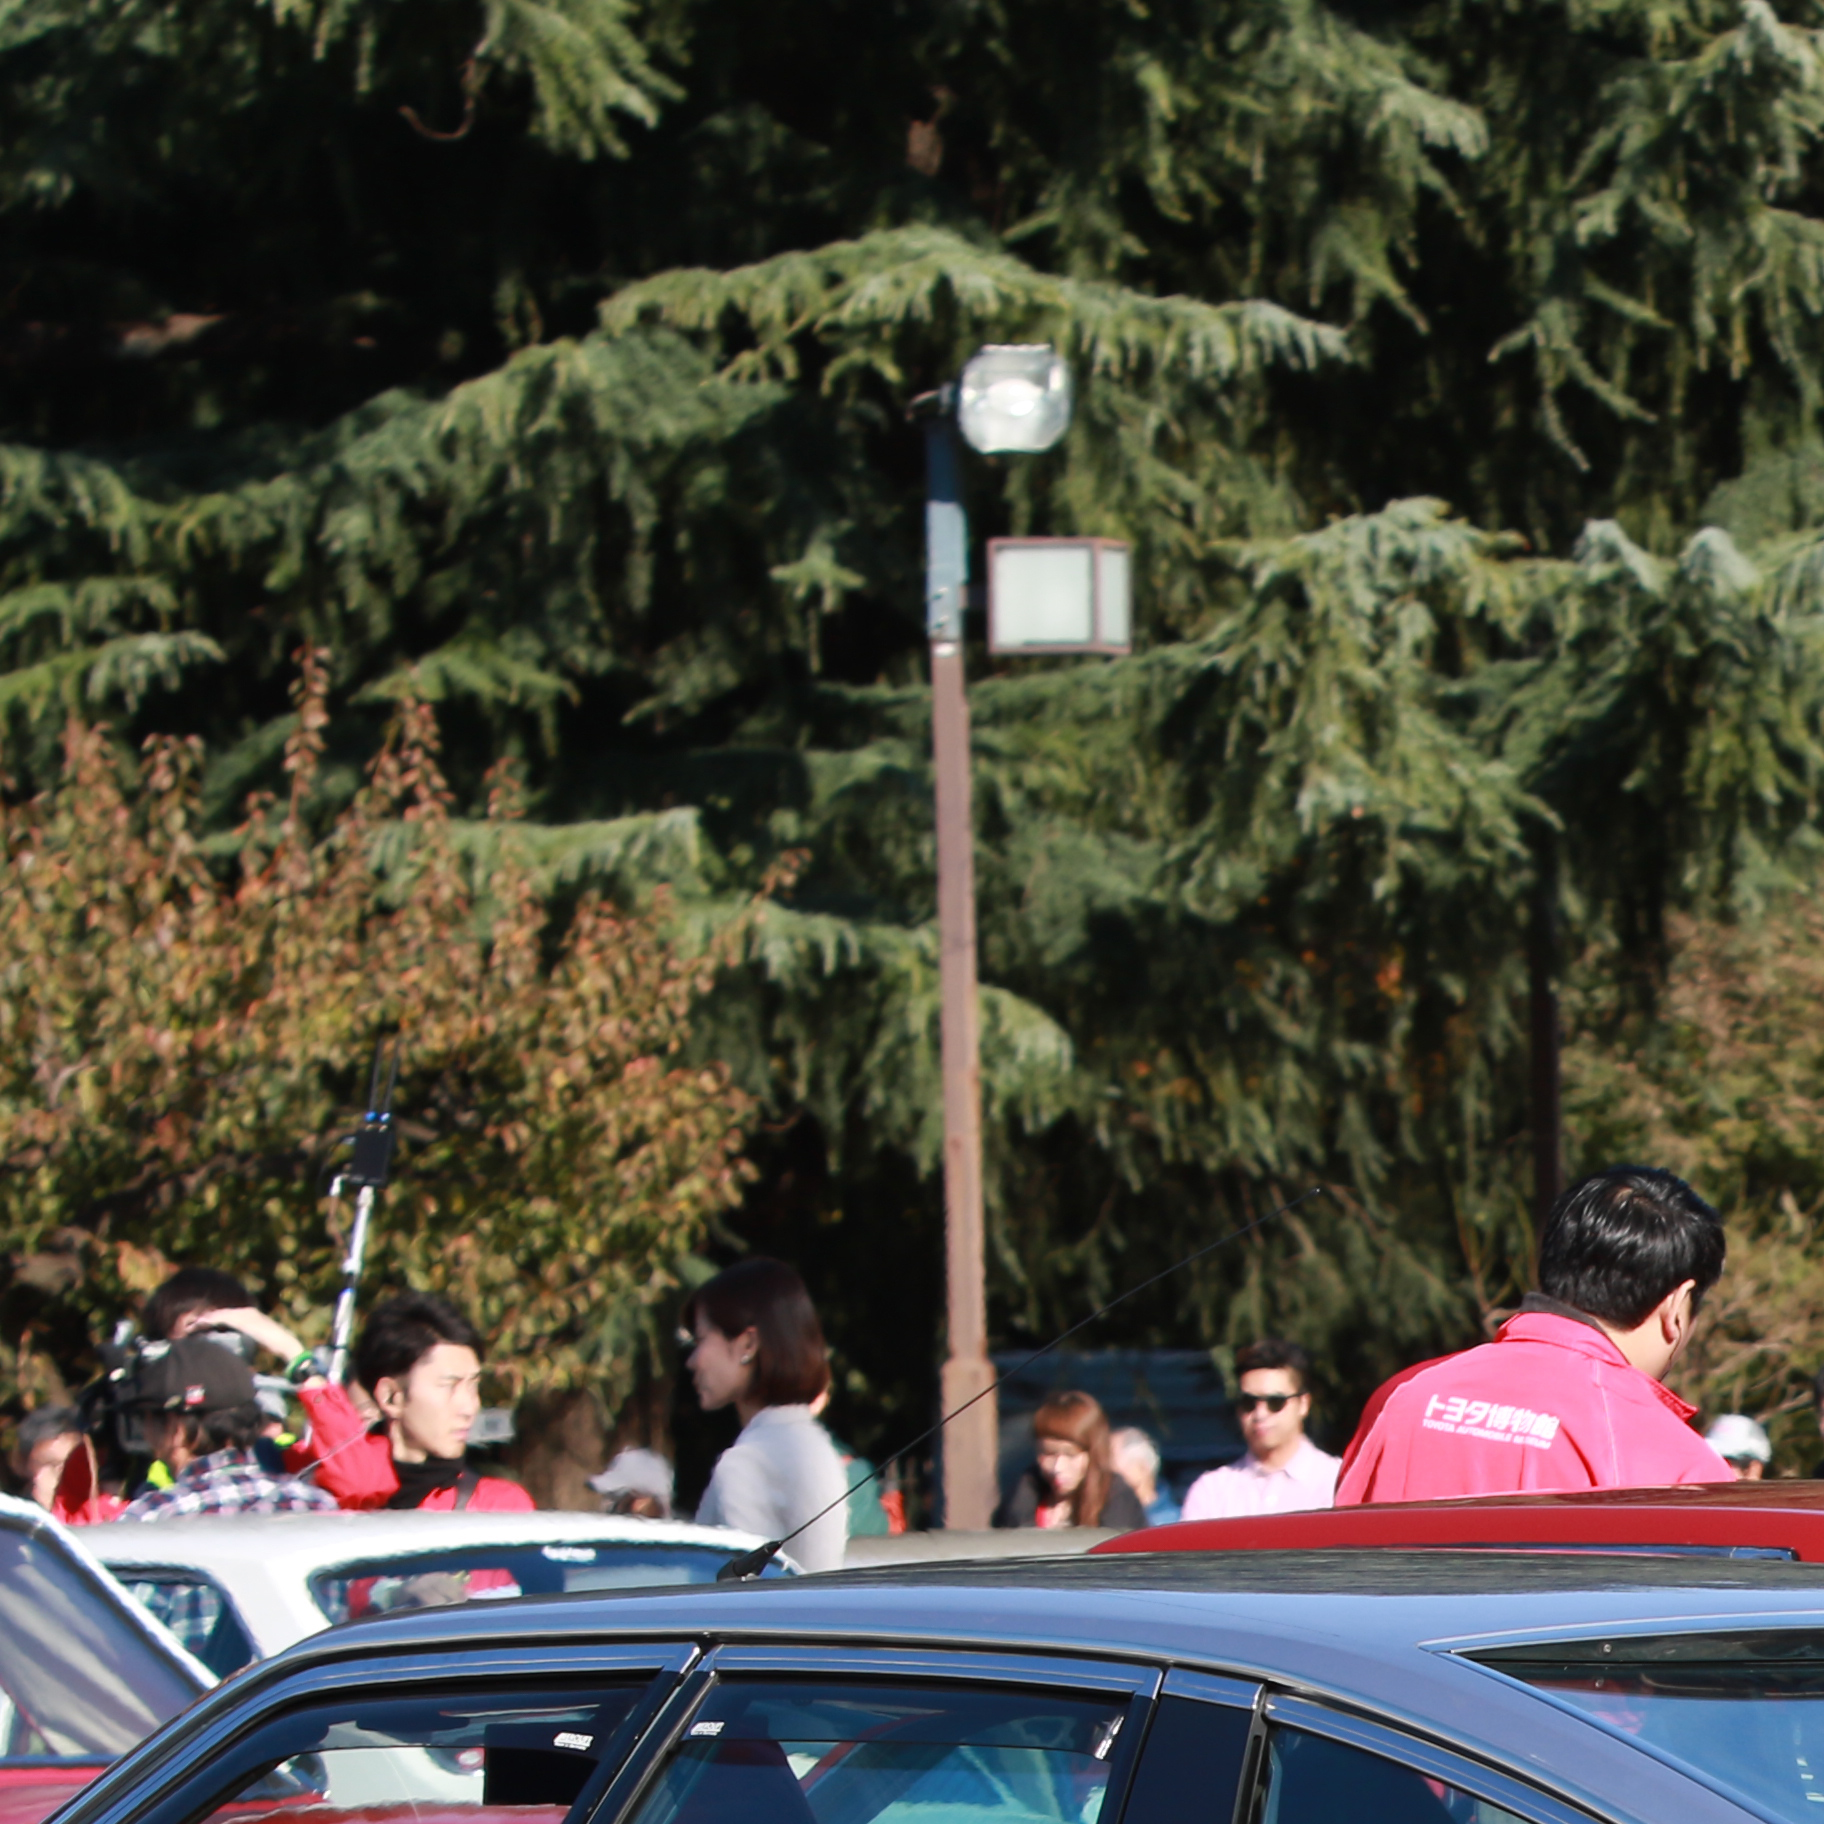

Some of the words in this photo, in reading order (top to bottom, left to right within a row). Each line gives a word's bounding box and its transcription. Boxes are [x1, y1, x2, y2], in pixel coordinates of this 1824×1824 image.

[1422, 1418, 1455, 1433] TOYOTA
[1456, 1425, 1513, 1444] AUTOMOBILE
[1425, 1393, 1560, 1440] トヨタ博物館
